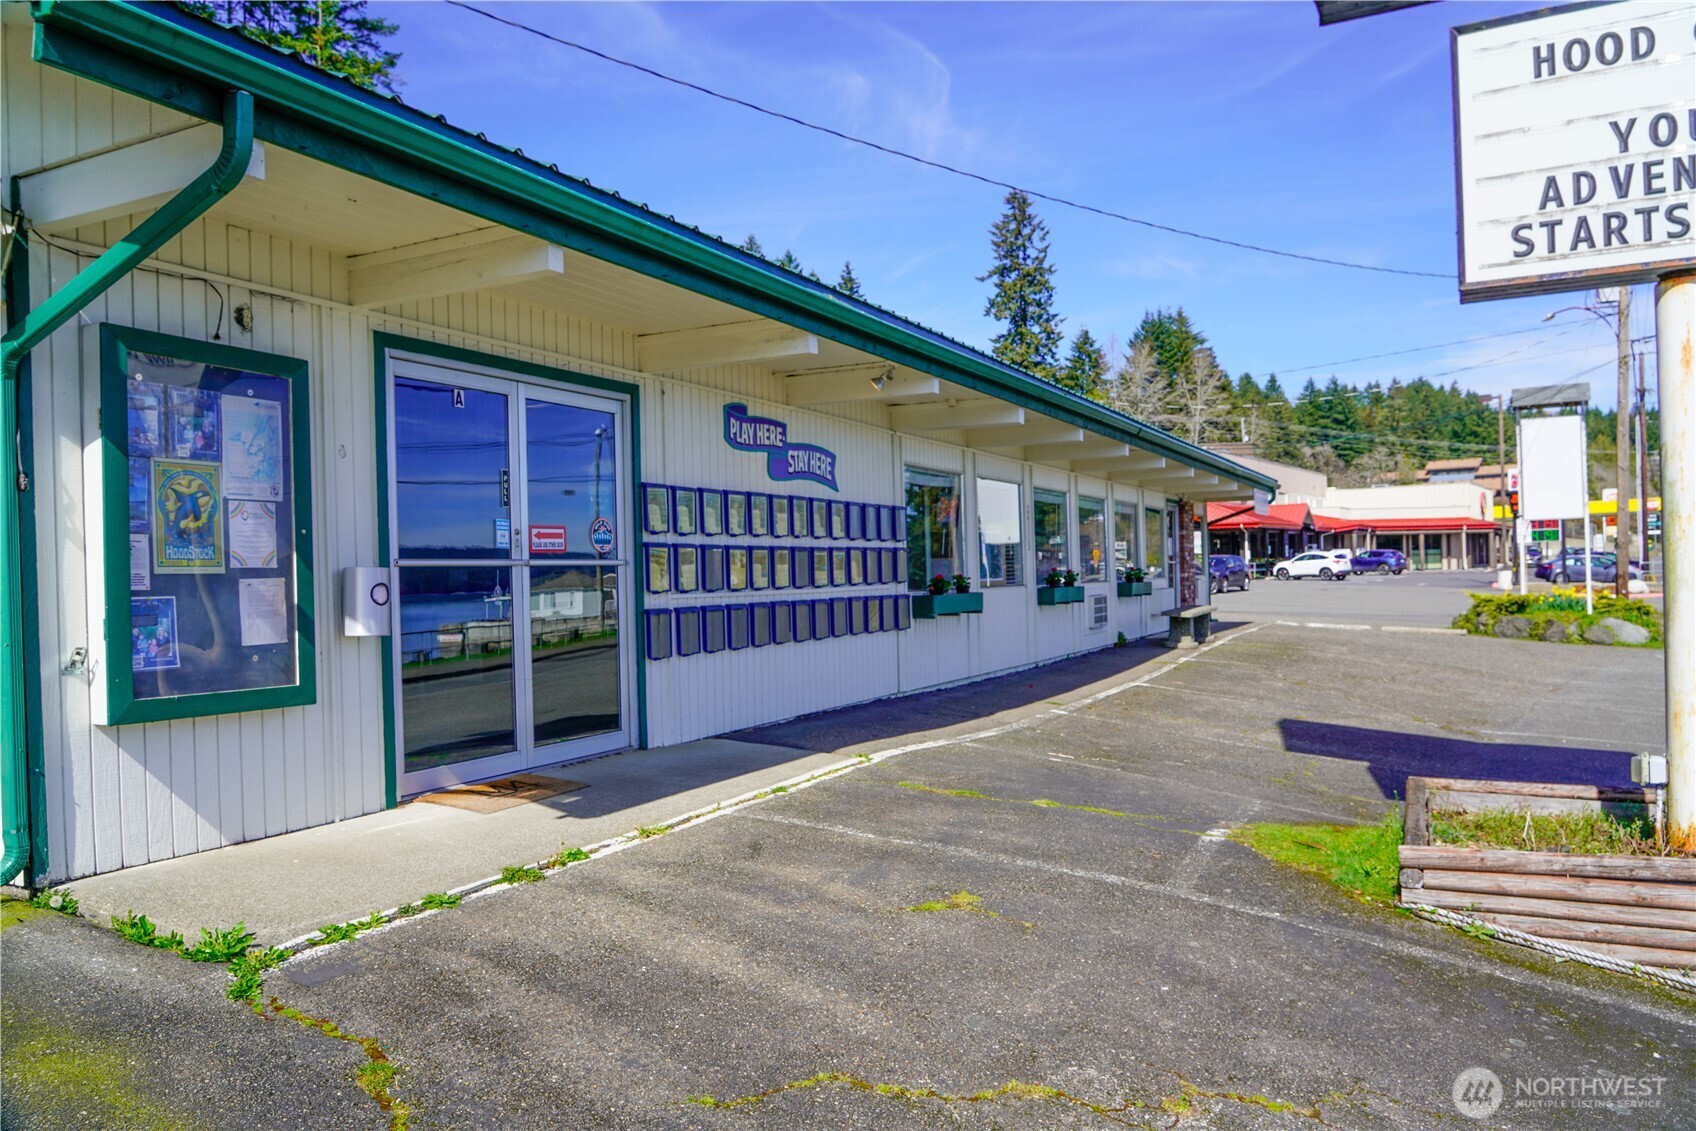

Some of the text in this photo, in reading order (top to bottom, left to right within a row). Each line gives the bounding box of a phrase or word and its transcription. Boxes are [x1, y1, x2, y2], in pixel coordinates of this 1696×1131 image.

[1532, 25, 1656, 79] HOOD
[1538, 154, 1696, 211] ADVEN
[1510, 202, 1691, 258] STARTS
[455, 390, 464, 407] A
[730, 416, 755, 445] PLAY
[788, 450, 832, 481] STAY HERE
